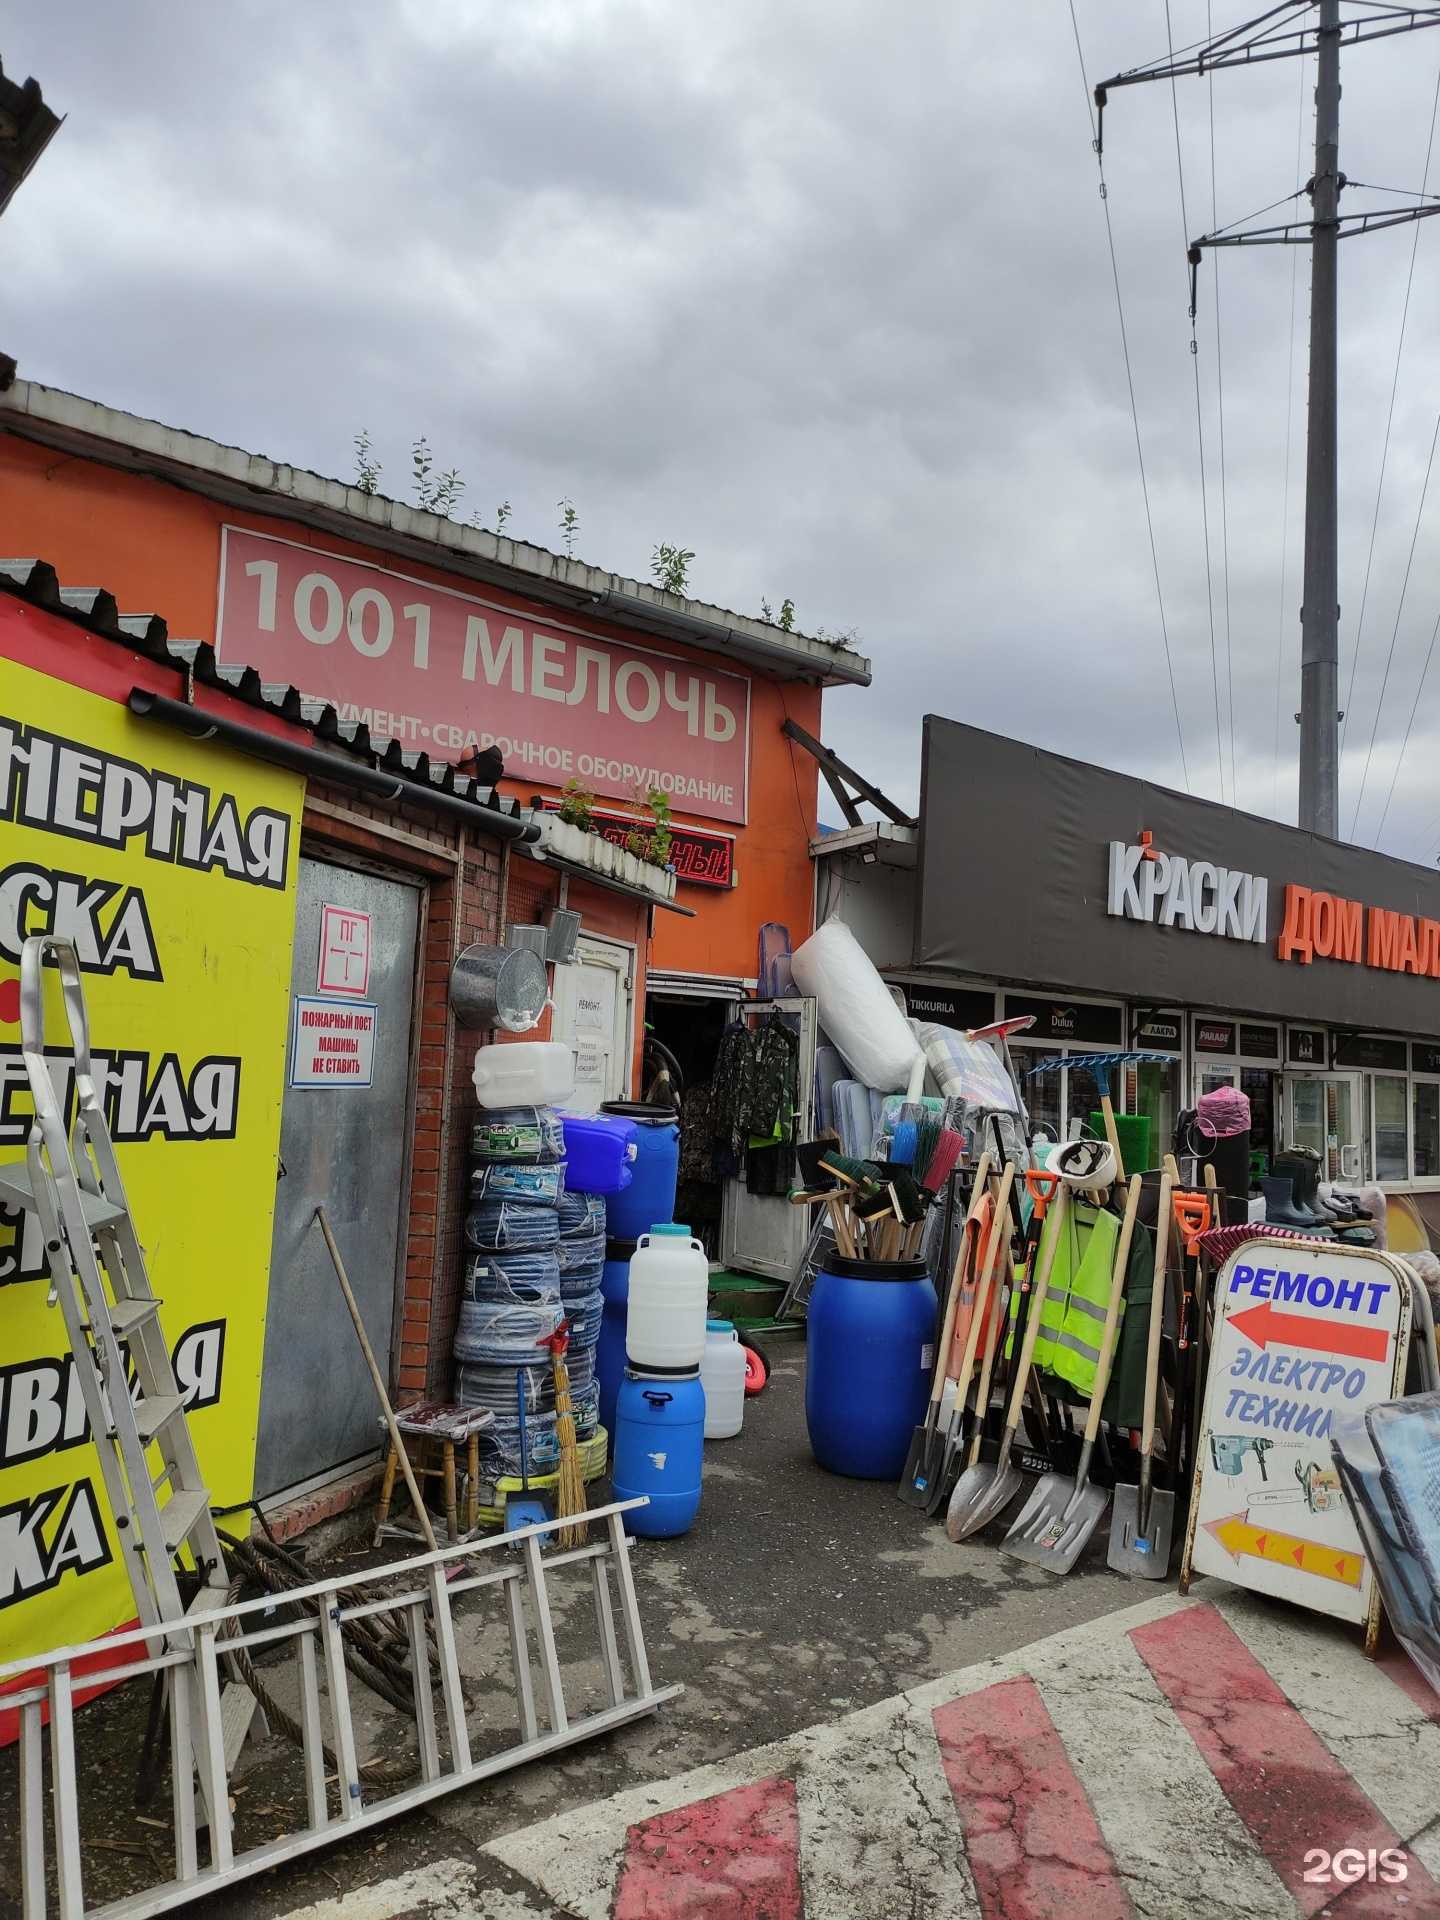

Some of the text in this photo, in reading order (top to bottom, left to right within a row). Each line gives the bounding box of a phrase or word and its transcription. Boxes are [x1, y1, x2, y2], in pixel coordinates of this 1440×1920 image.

[245, 559, 736, 743] 1001 МЕЛОЧЬ
[577, 754, 734, 806] ОБОРУДОВАНИЕ
[1107, 840, 1268, 944] КРАСКИ
[340, 919, 358, 943] ПГ
[1277, 884, 1363, 964] ДОМ
[910, 999, 956, 1014] TIKKURILA
[301, 1010, 373, 1031] ПОЖАРНЫЙ ПОСТ
[1051, 1015, 1075, 1029] Dulux
[318, 1036, 359, 1054] МАШИНЫ
[1200, 1030, 1229, 1043] PARADE
[312, 1057, 361, 1075] НЕ СТАВИТЬ
[1229, 1264, 1391, 1315] РЕМОНТ
[1230, 1346, 1367, 1400] ЭЛЕКТРО
